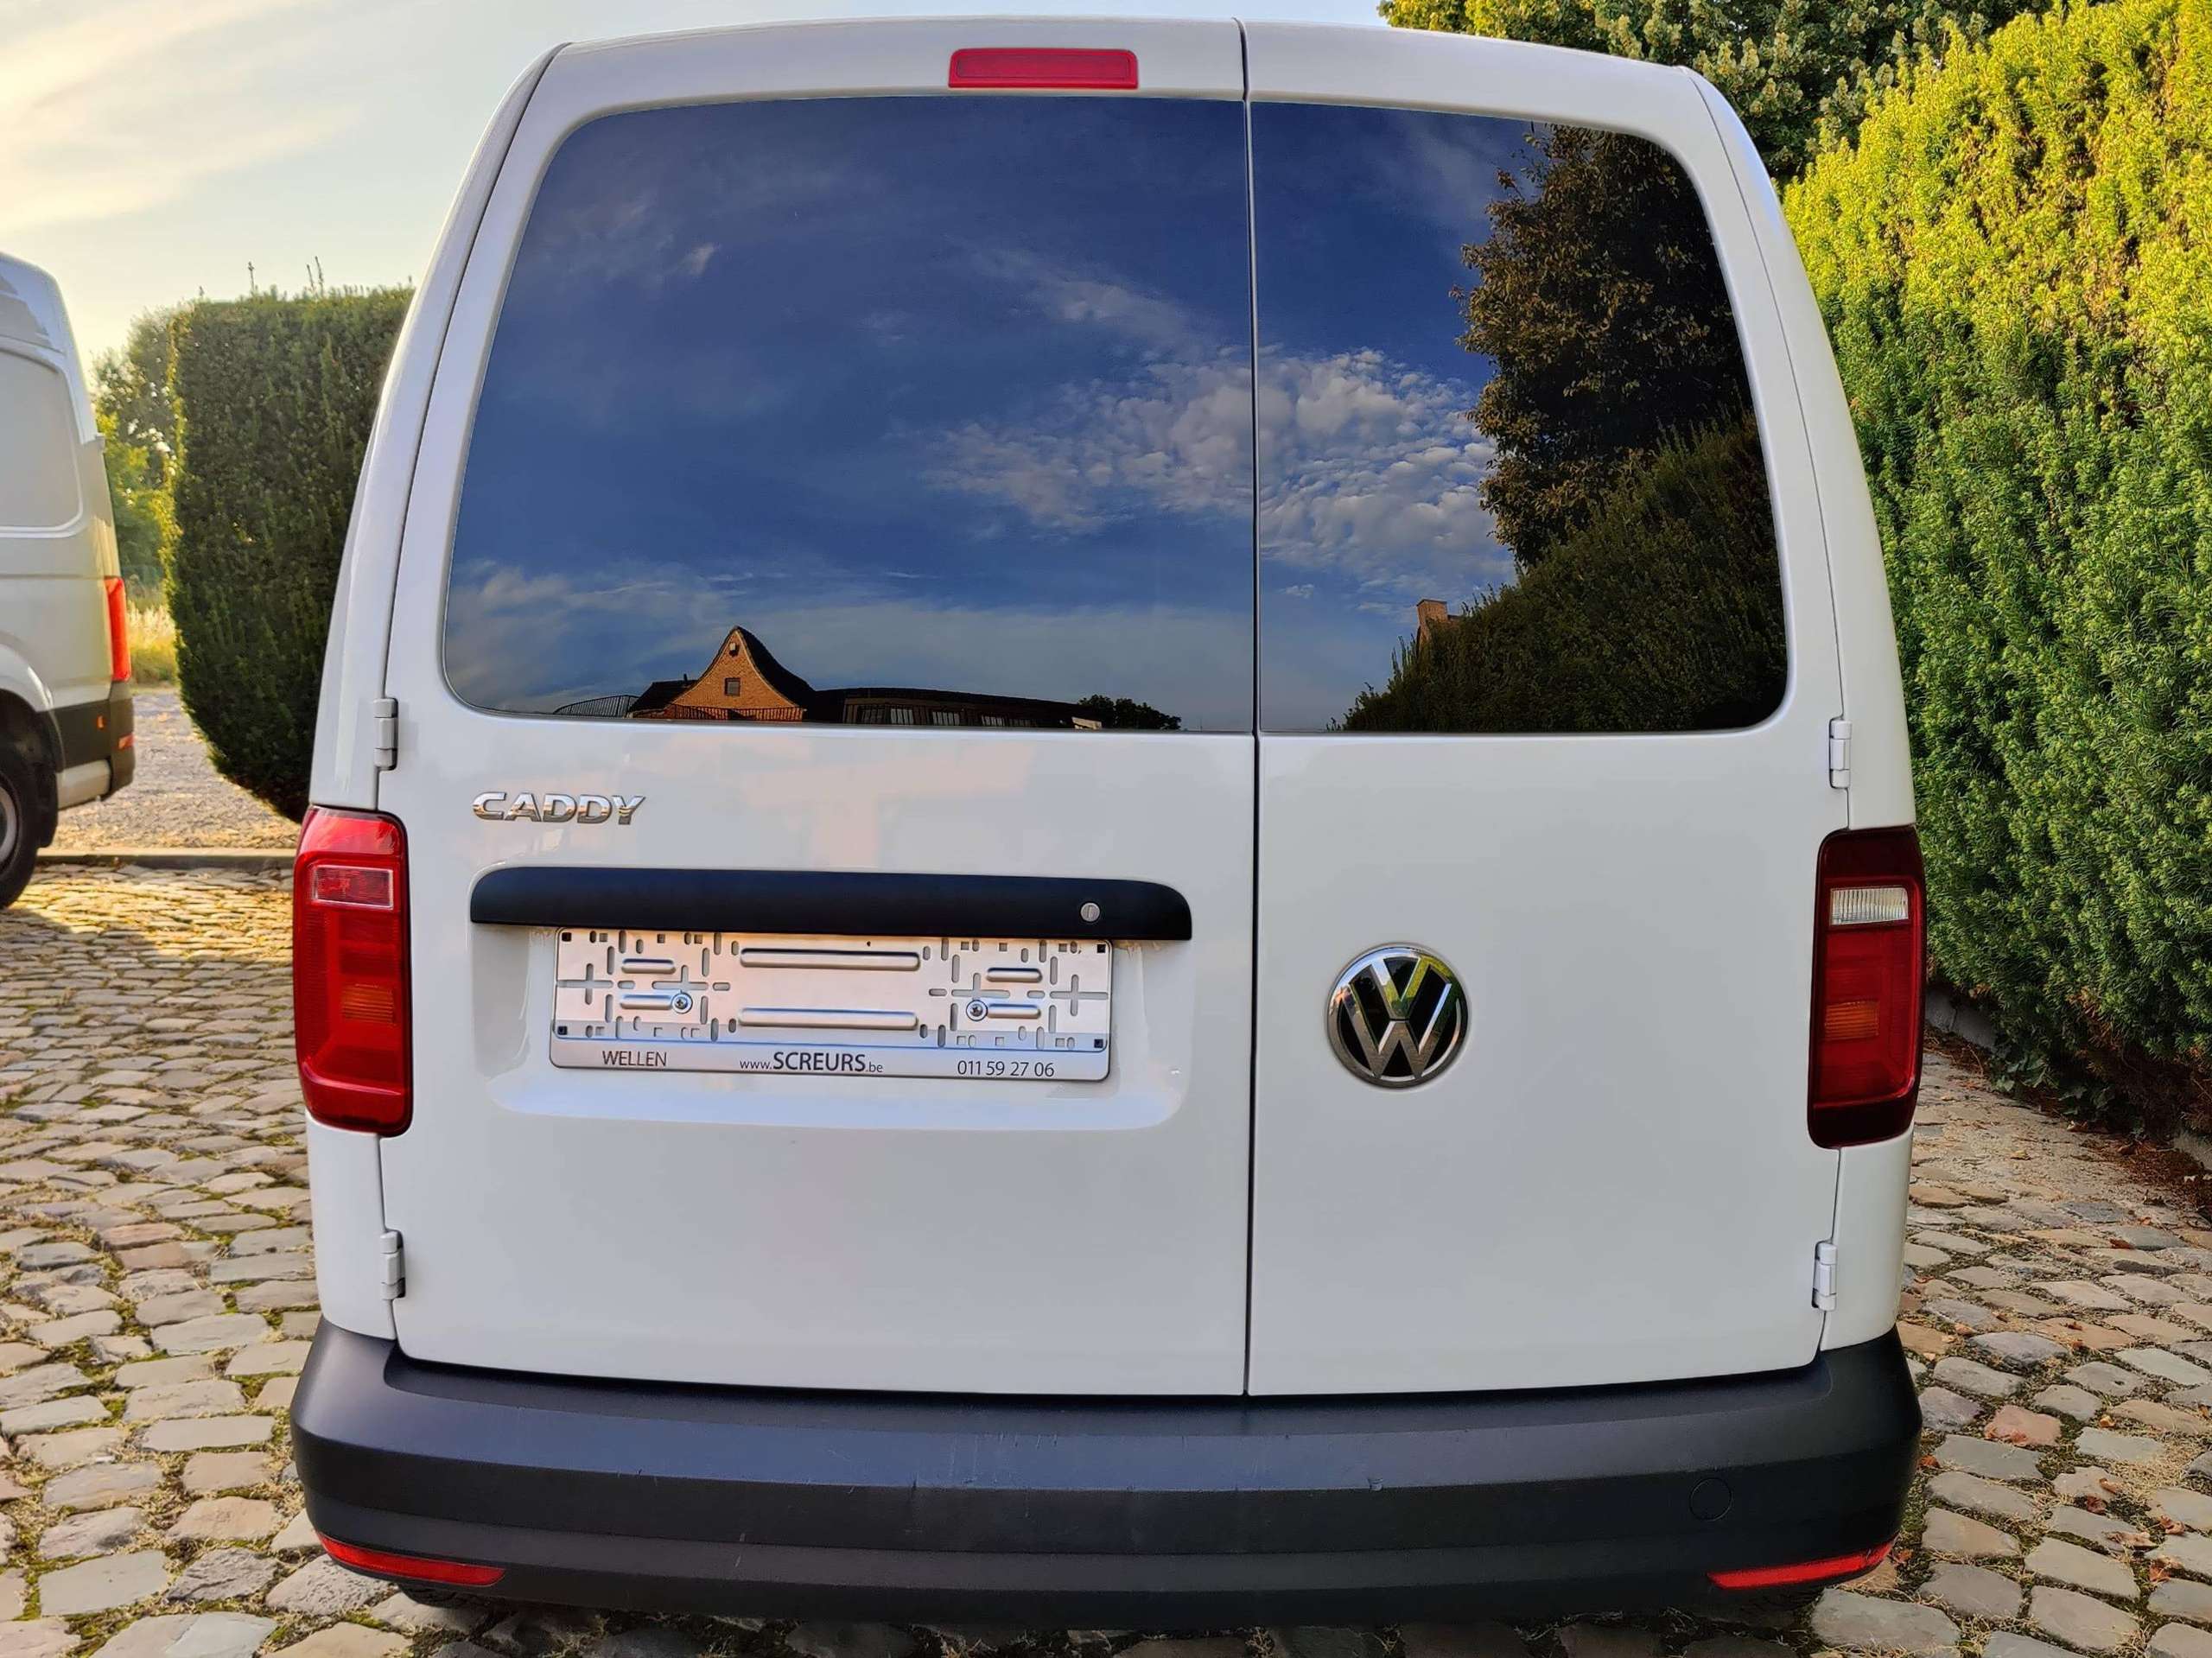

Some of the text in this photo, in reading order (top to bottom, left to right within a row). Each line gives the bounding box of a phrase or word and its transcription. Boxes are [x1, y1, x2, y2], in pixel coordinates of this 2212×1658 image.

[472, 791, 646, 825] CADDY
[602, 1050, 667, 1067] WELLEN
[740, 1051, 884, 1073] www.SCREURS.be
[957, 1060, 1055, 1077] 011 59 27 06
